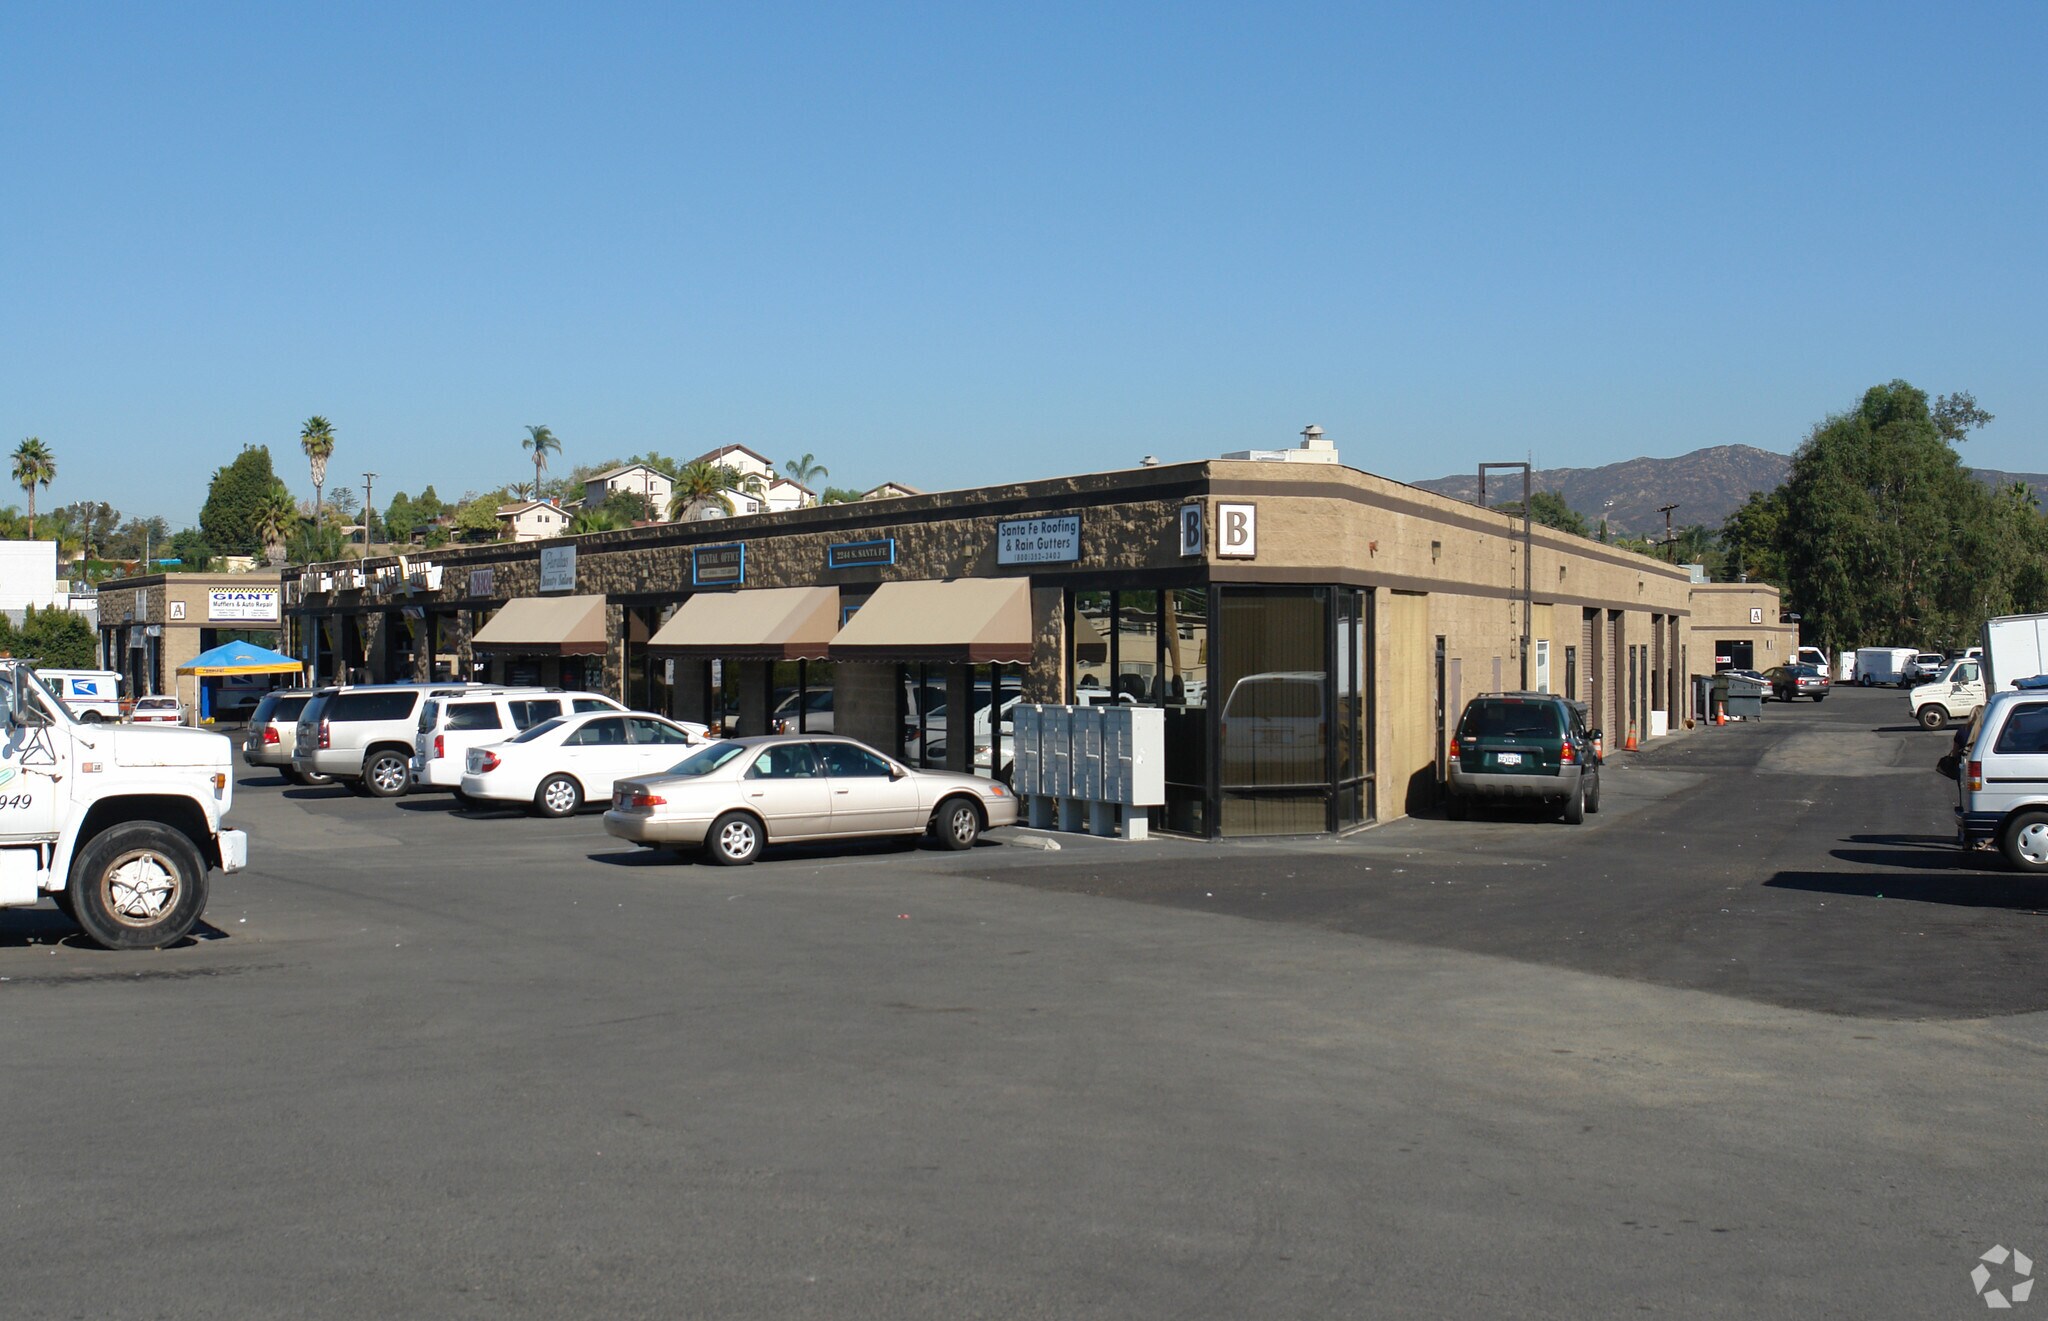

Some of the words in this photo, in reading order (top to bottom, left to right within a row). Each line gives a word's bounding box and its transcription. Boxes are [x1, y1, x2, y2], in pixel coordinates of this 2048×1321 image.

[1001, 524, 1025, 536] Santa
[1028, 522, 1038, 535] Fe
[1041, 519, 1076, 535] Roofing
[1186, 511, 1199, 547] B
[1226, 511, 1248, 546] B
[1006, 539, 1012, 551] &
[1015, 538, 1034, 551] Rain
[1037, 537, 1070, 550] Gutters
[699, 553, 719, 564] RENTAL
[720, 551, 740, 563] OFFICE
[857, 548, 877, 557] SANTA
[878, 547, 887, 556] FE
[173, 604, 182, 617] A
[1753, 610, 1760, 621] A
[0, 794, 32, 809] 949
